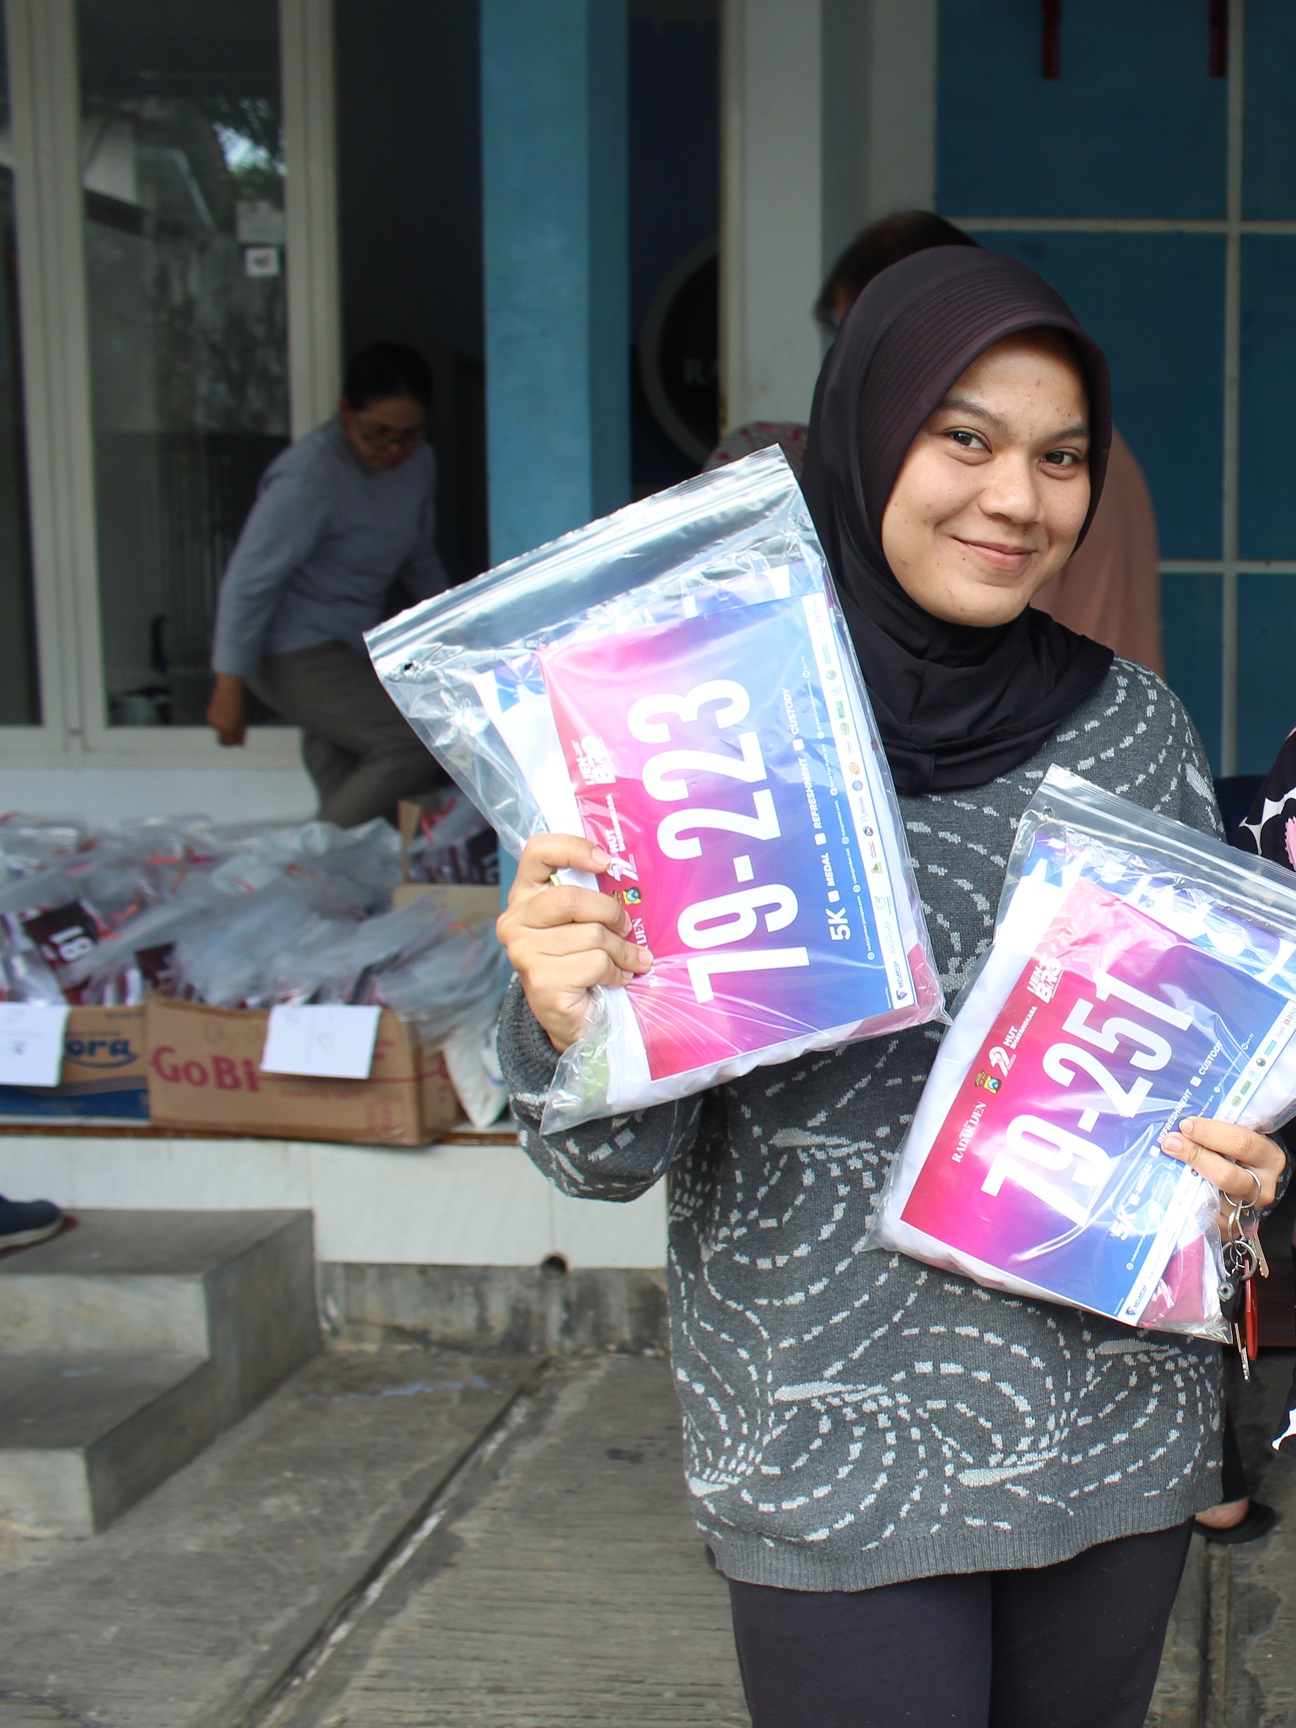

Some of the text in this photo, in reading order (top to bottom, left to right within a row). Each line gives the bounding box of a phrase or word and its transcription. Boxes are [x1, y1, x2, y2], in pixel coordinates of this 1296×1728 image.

[604, 830, 619, 853] HUT
[606, 794, 625, 851] BHAYANGKARA
[627, 680, 809, 1003] 79-223
[781, 688, 850, 940] 5K MEDAL REFRESHMENT CUSTODY
[1027, 966, 1043, 993] IJEN
[1003, 1026, 1018, 1046] HUT
[1009, 1007, 1037, 1049] BHAYANGKARA
[981, 970, 1193, 1226] 79-251
[952, 1102, 986, 1162] RADAR IJEN
[1109, 1204, 1137, 1240] 5K
[1136, 1164, 1152, 1192] MEDAL
[1157, 1089, 1192, 1144] REFRESHMENT
[1199, 1040, 1222, 1075] CUSTODY
